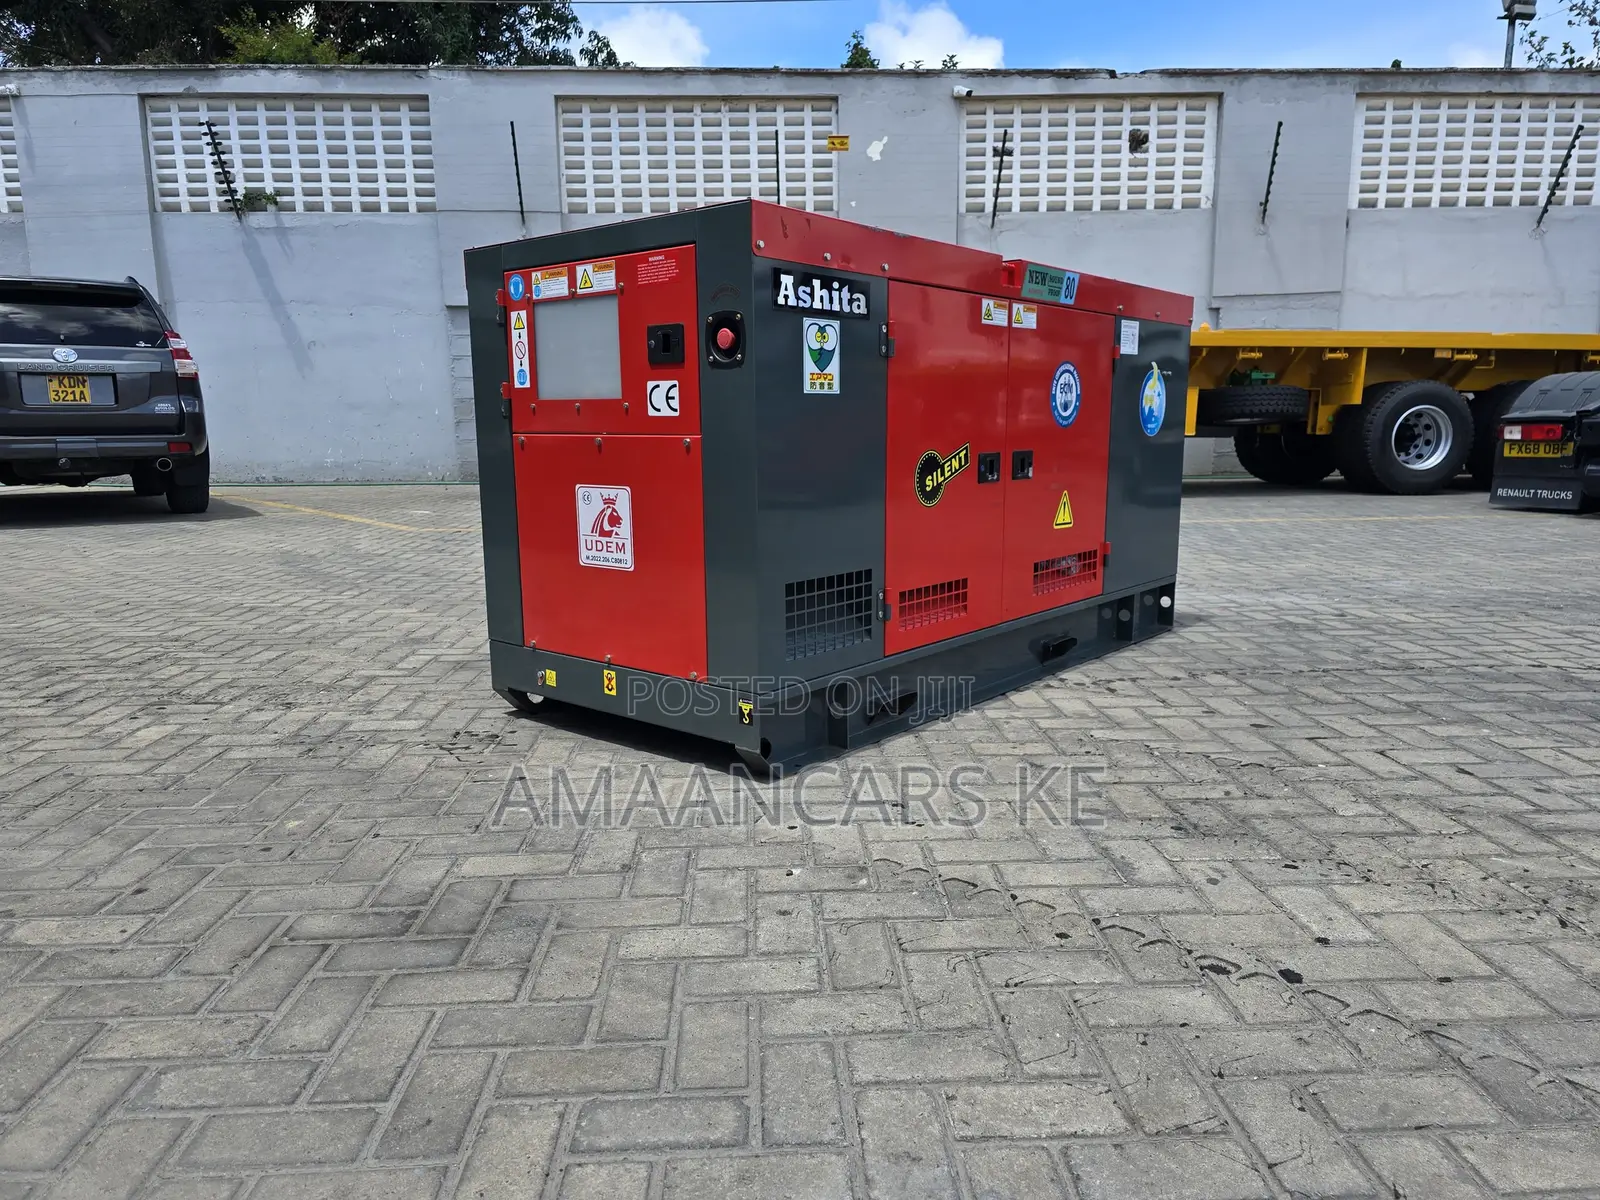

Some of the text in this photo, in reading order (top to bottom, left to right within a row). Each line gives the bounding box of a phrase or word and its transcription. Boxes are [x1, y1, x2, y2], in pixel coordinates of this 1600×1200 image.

[1028, 269, 1048, 286] NEW
[777, 273, 868, 315] Ashita
[1064, 276, 1076, 300] 80
[17, 362, 115, 372] LAND CRUISER
[58, 375, 87, 389] KDN
[52, 389, 88, 403] 321A
[648, 383, 679, 413] CE
[1508, 443, 1540, 454] FX68
[925, 449, 967, 492] SILENT
[1497, 488, 1573, 500] RENAULT TRUCKS
[585, 539, 626, 554] UDEM
